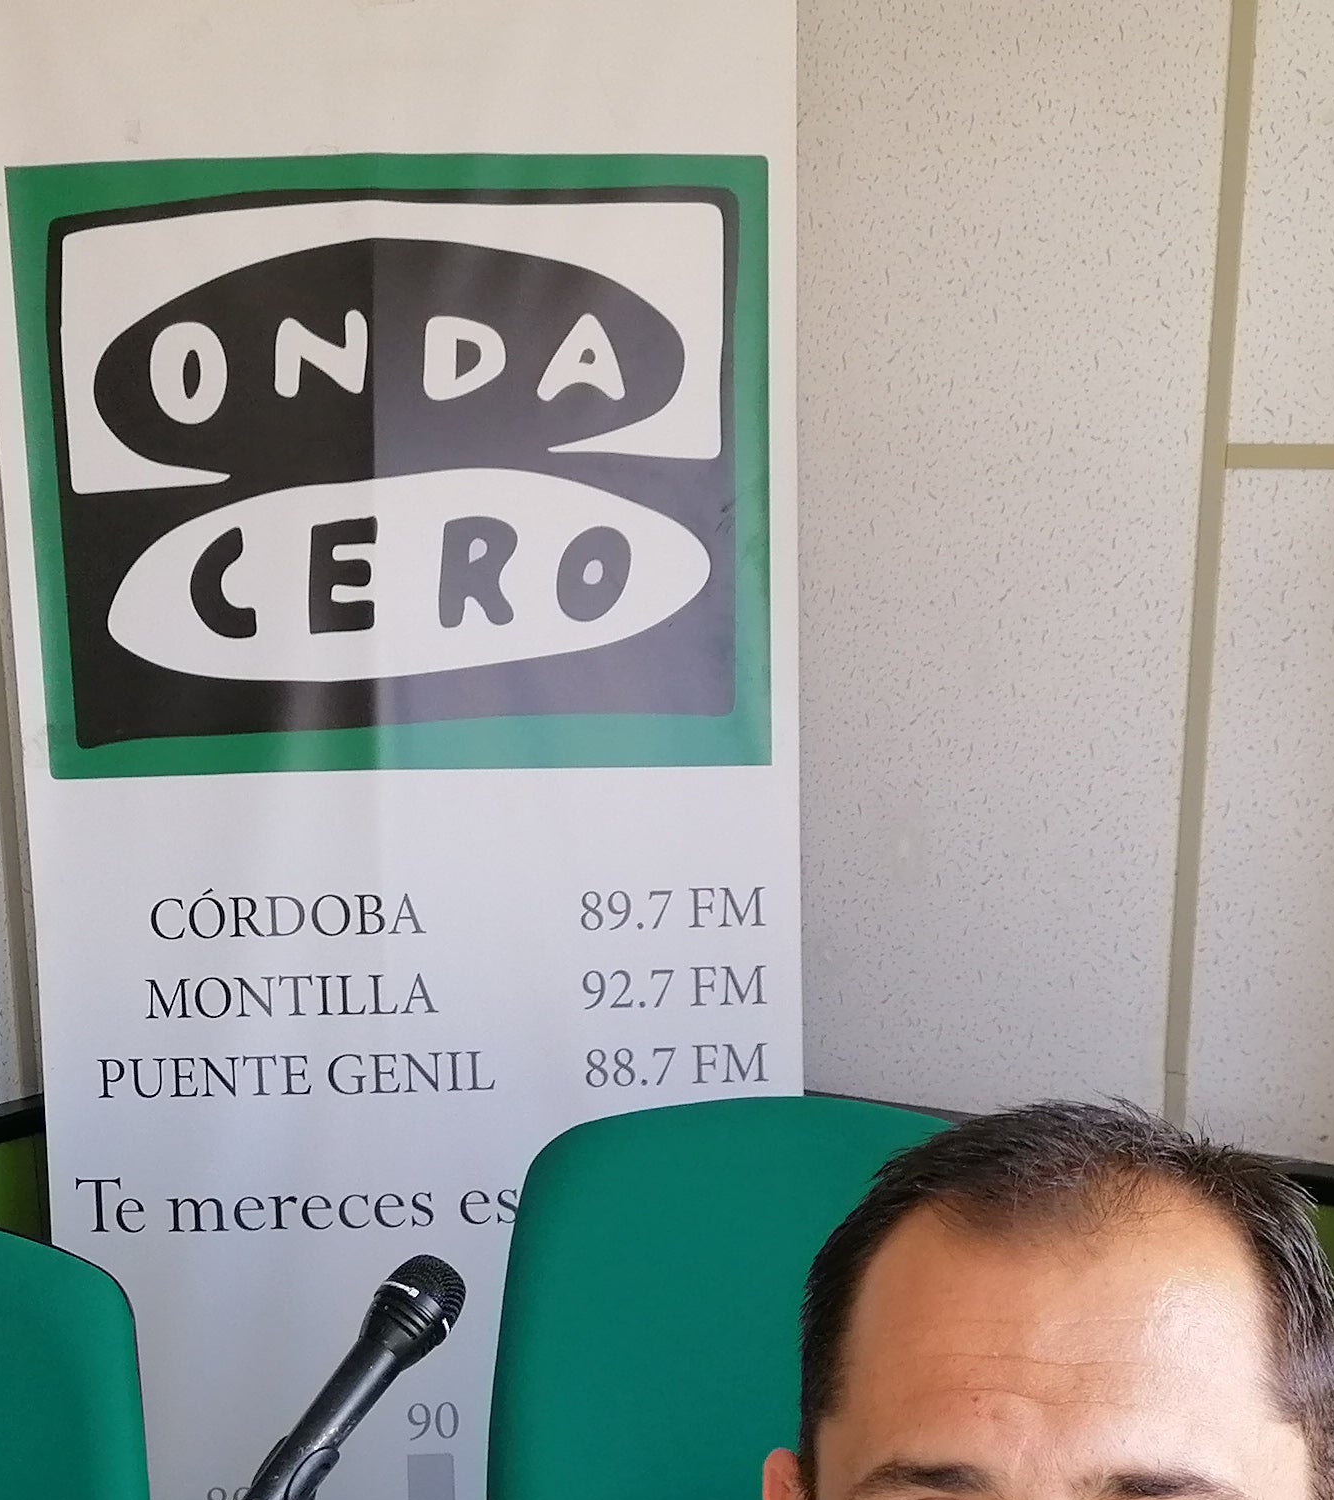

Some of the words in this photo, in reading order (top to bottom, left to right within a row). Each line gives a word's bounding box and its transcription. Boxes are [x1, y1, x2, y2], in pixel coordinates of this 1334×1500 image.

[150, 309, 626, 424] ONDA
[190, 516, 632, 639] CERO
[150, 888, 427, 940] CÓRDOBA
[580, 889, 674, 931] 89.7
[688, 886, 767, 928] FM
[144, 972, 439, 1020] MONTILLA
[581, 968, 675, 1011] 92.7
[690, 965, 768, 1007] FM
[97, 1054, 313, 1099] PUENTE
[327, 1051, 496, 1097] GENIL
[585, 1046, 677, 1088] 88.7
[692, 1043, 770, 1084] FM
[75, 1177, 146, 1234] Te
[165, 1191, 435, 1233] mereces
[407, 1402, 460, 1441] 90
